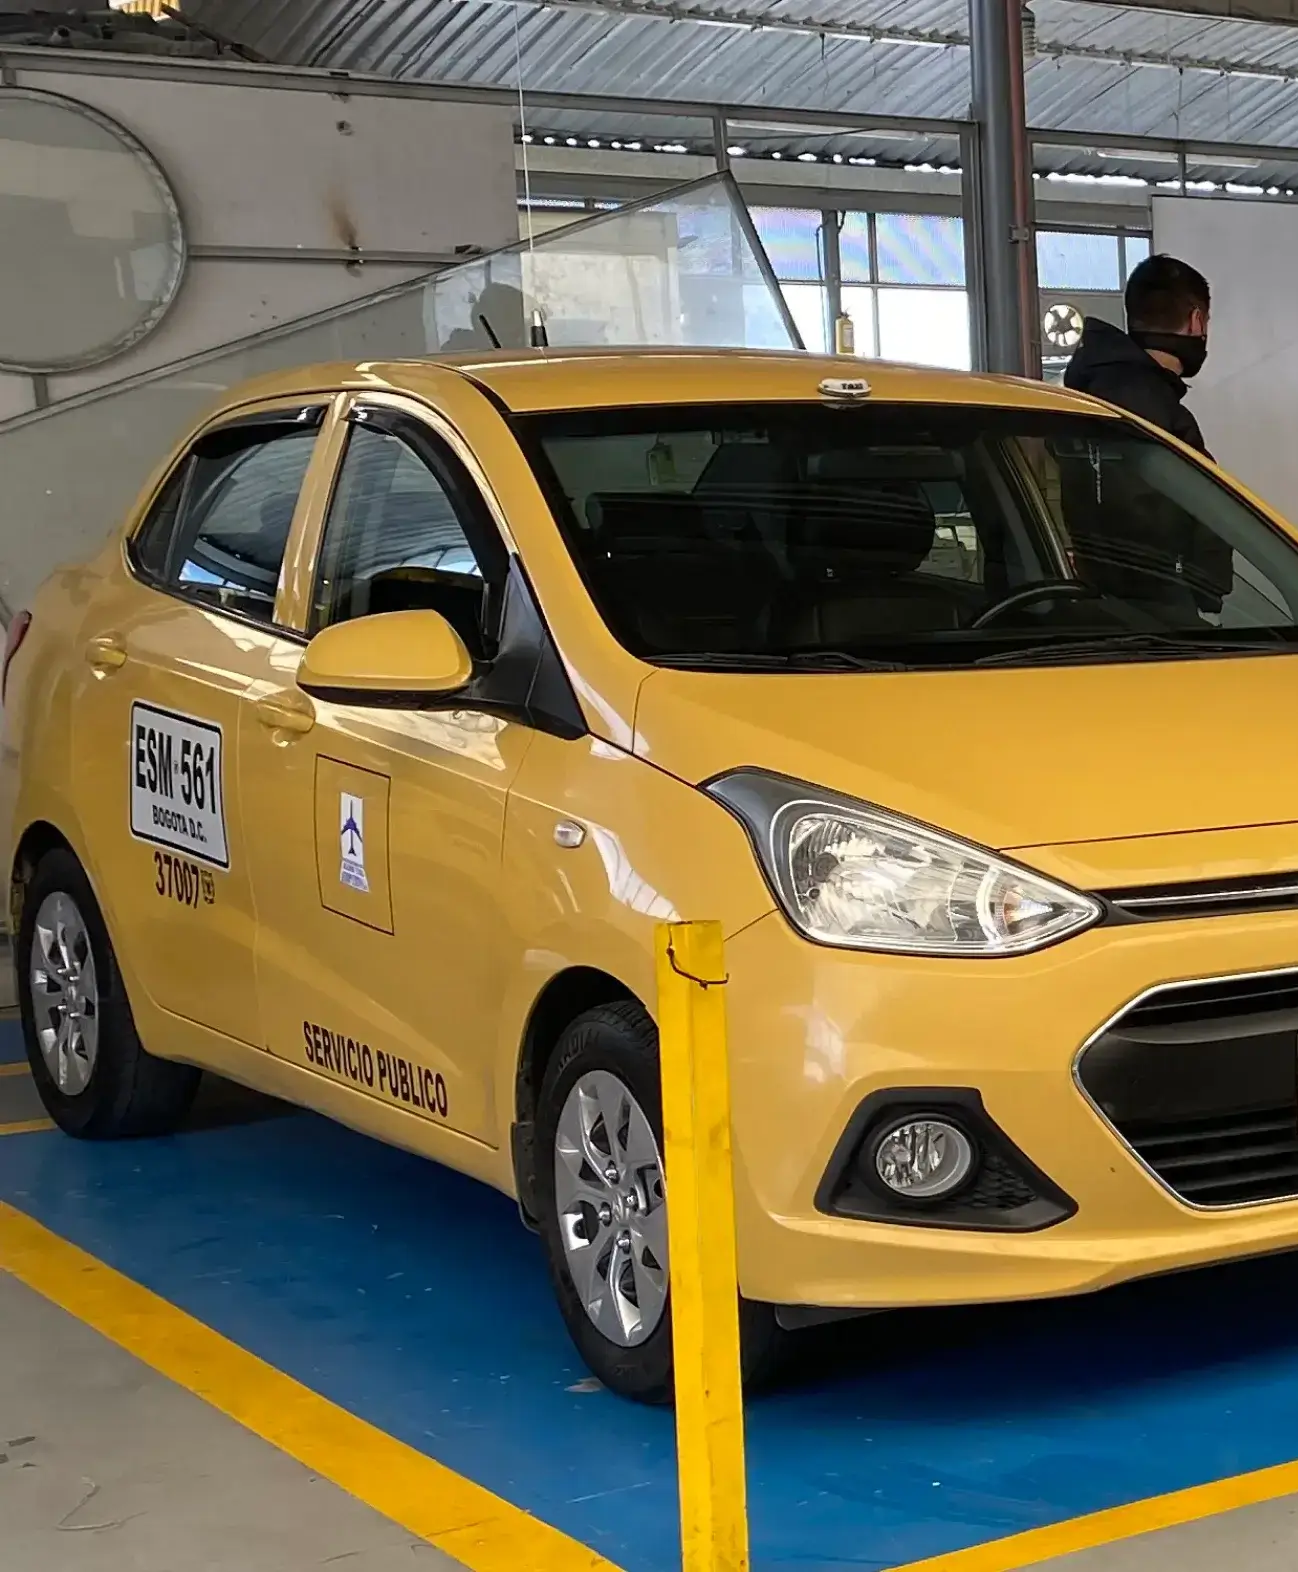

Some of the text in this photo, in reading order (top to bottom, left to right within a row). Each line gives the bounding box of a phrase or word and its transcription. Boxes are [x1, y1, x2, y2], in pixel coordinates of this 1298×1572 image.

[152, 804, 189, 837] BOGOTA
[154, 850, 200, 909] 37007
[303, 1020, 448, 1118] SERVICIO PUBLICO
